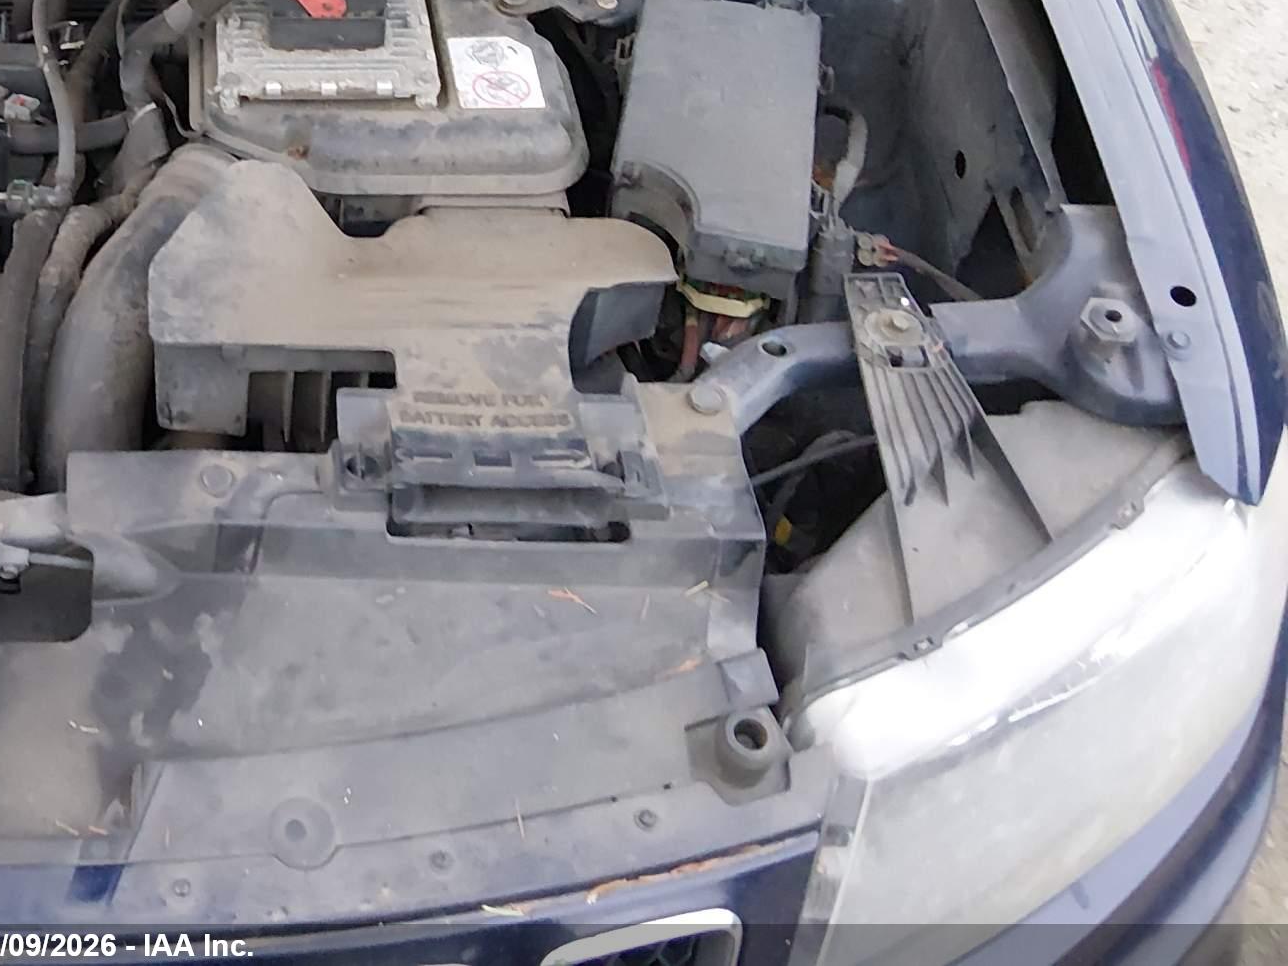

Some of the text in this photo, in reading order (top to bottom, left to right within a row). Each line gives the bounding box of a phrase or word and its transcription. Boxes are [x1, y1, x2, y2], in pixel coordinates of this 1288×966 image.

[413, 391, 548, 407] REMOVE FOR
[399, 410, 570, 428] BATTERY ACCESS
